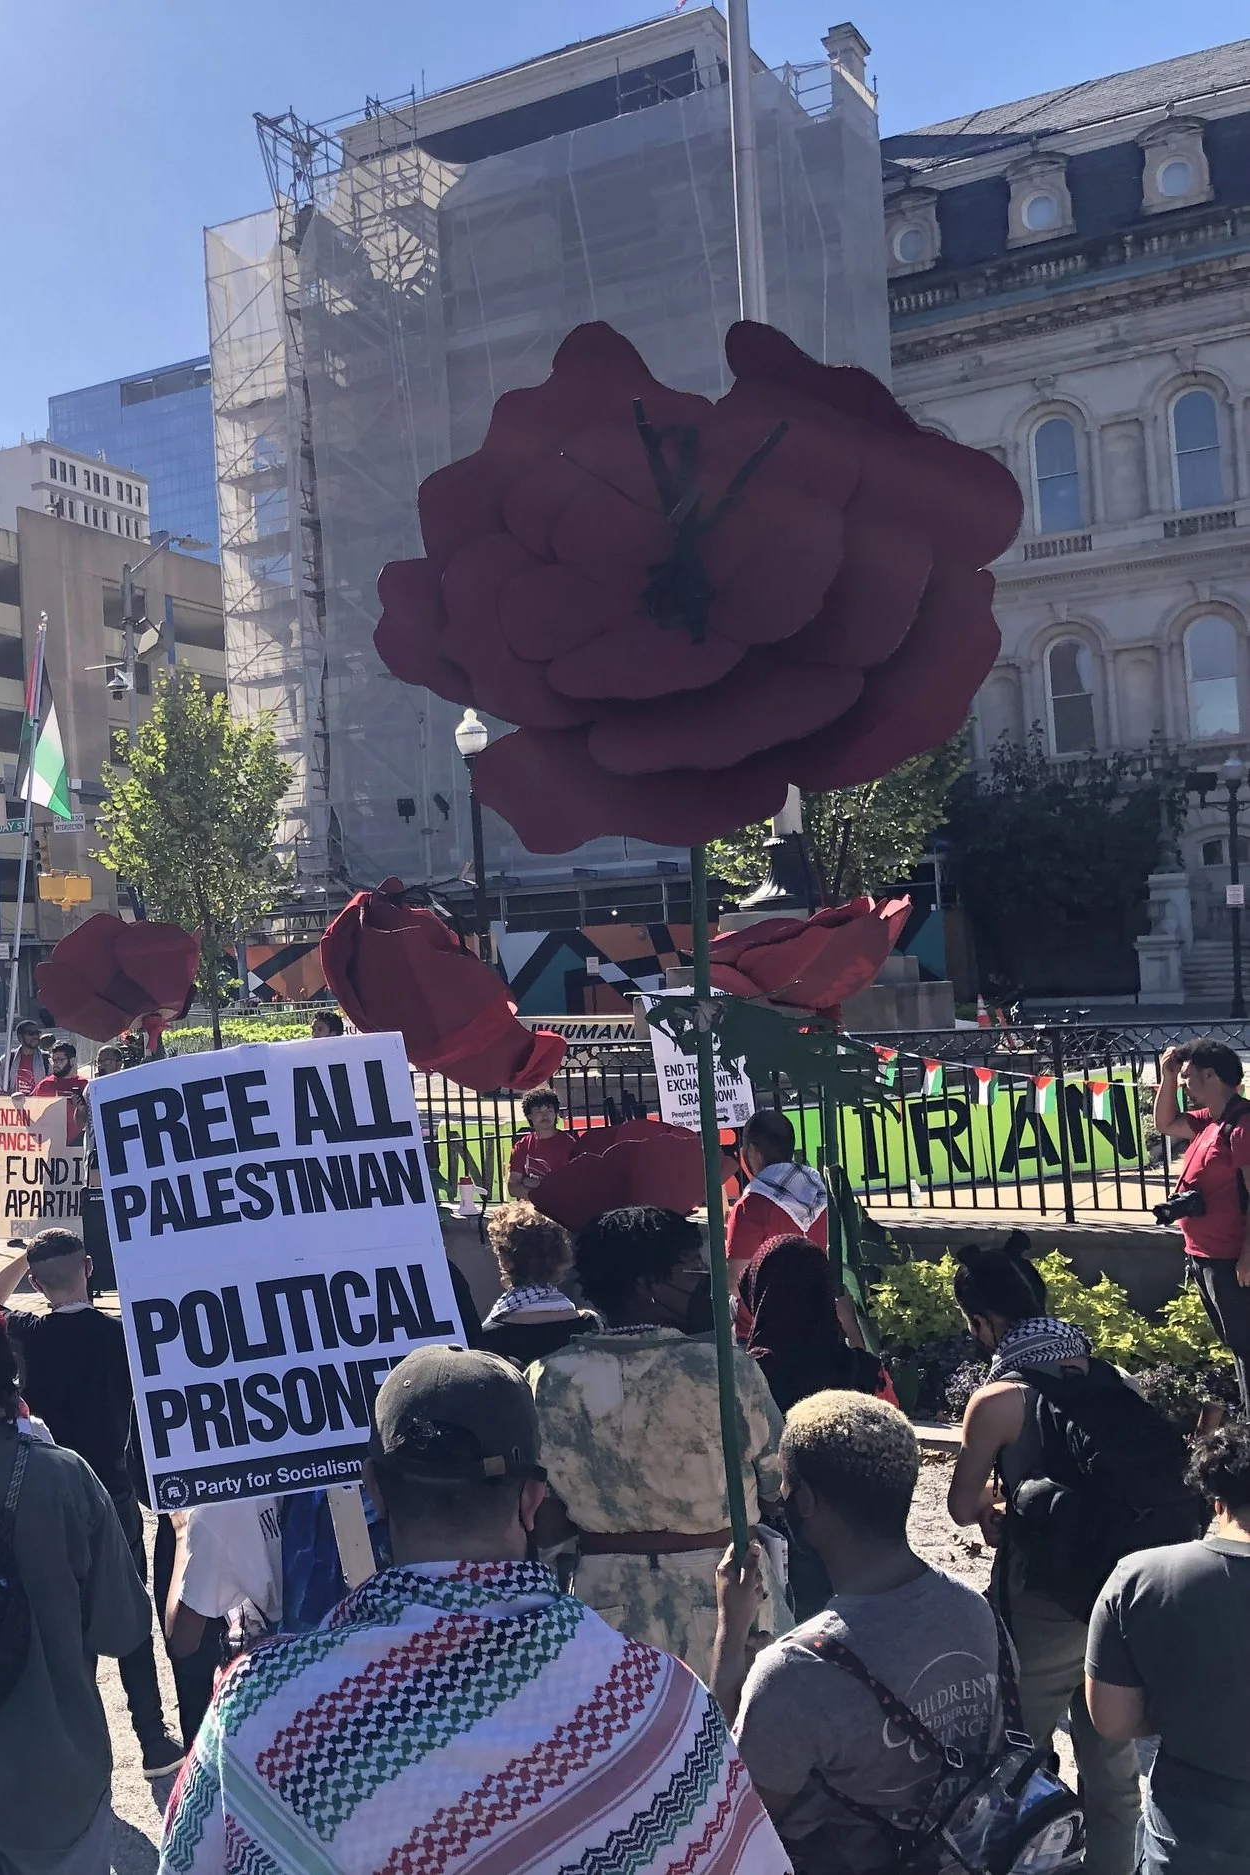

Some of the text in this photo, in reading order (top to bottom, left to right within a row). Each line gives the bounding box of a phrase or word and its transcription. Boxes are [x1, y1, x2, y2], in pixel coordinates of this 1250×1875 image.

[100, 1060, 414, 1177] FREE ALL
[664, 1063, 685, 1077] END
[853, 1078, 1137, 1183] IRAN
[110, 1149, 426, 1242] PALESTINIAN
[132, 1264, 455, 1377] POLITICAL
[143, 1356, 406, 1459] PRISONE
[194, 1456, 363, 1496] Party for Socialism
[933, 1703, 979, 1729] DESERVE
